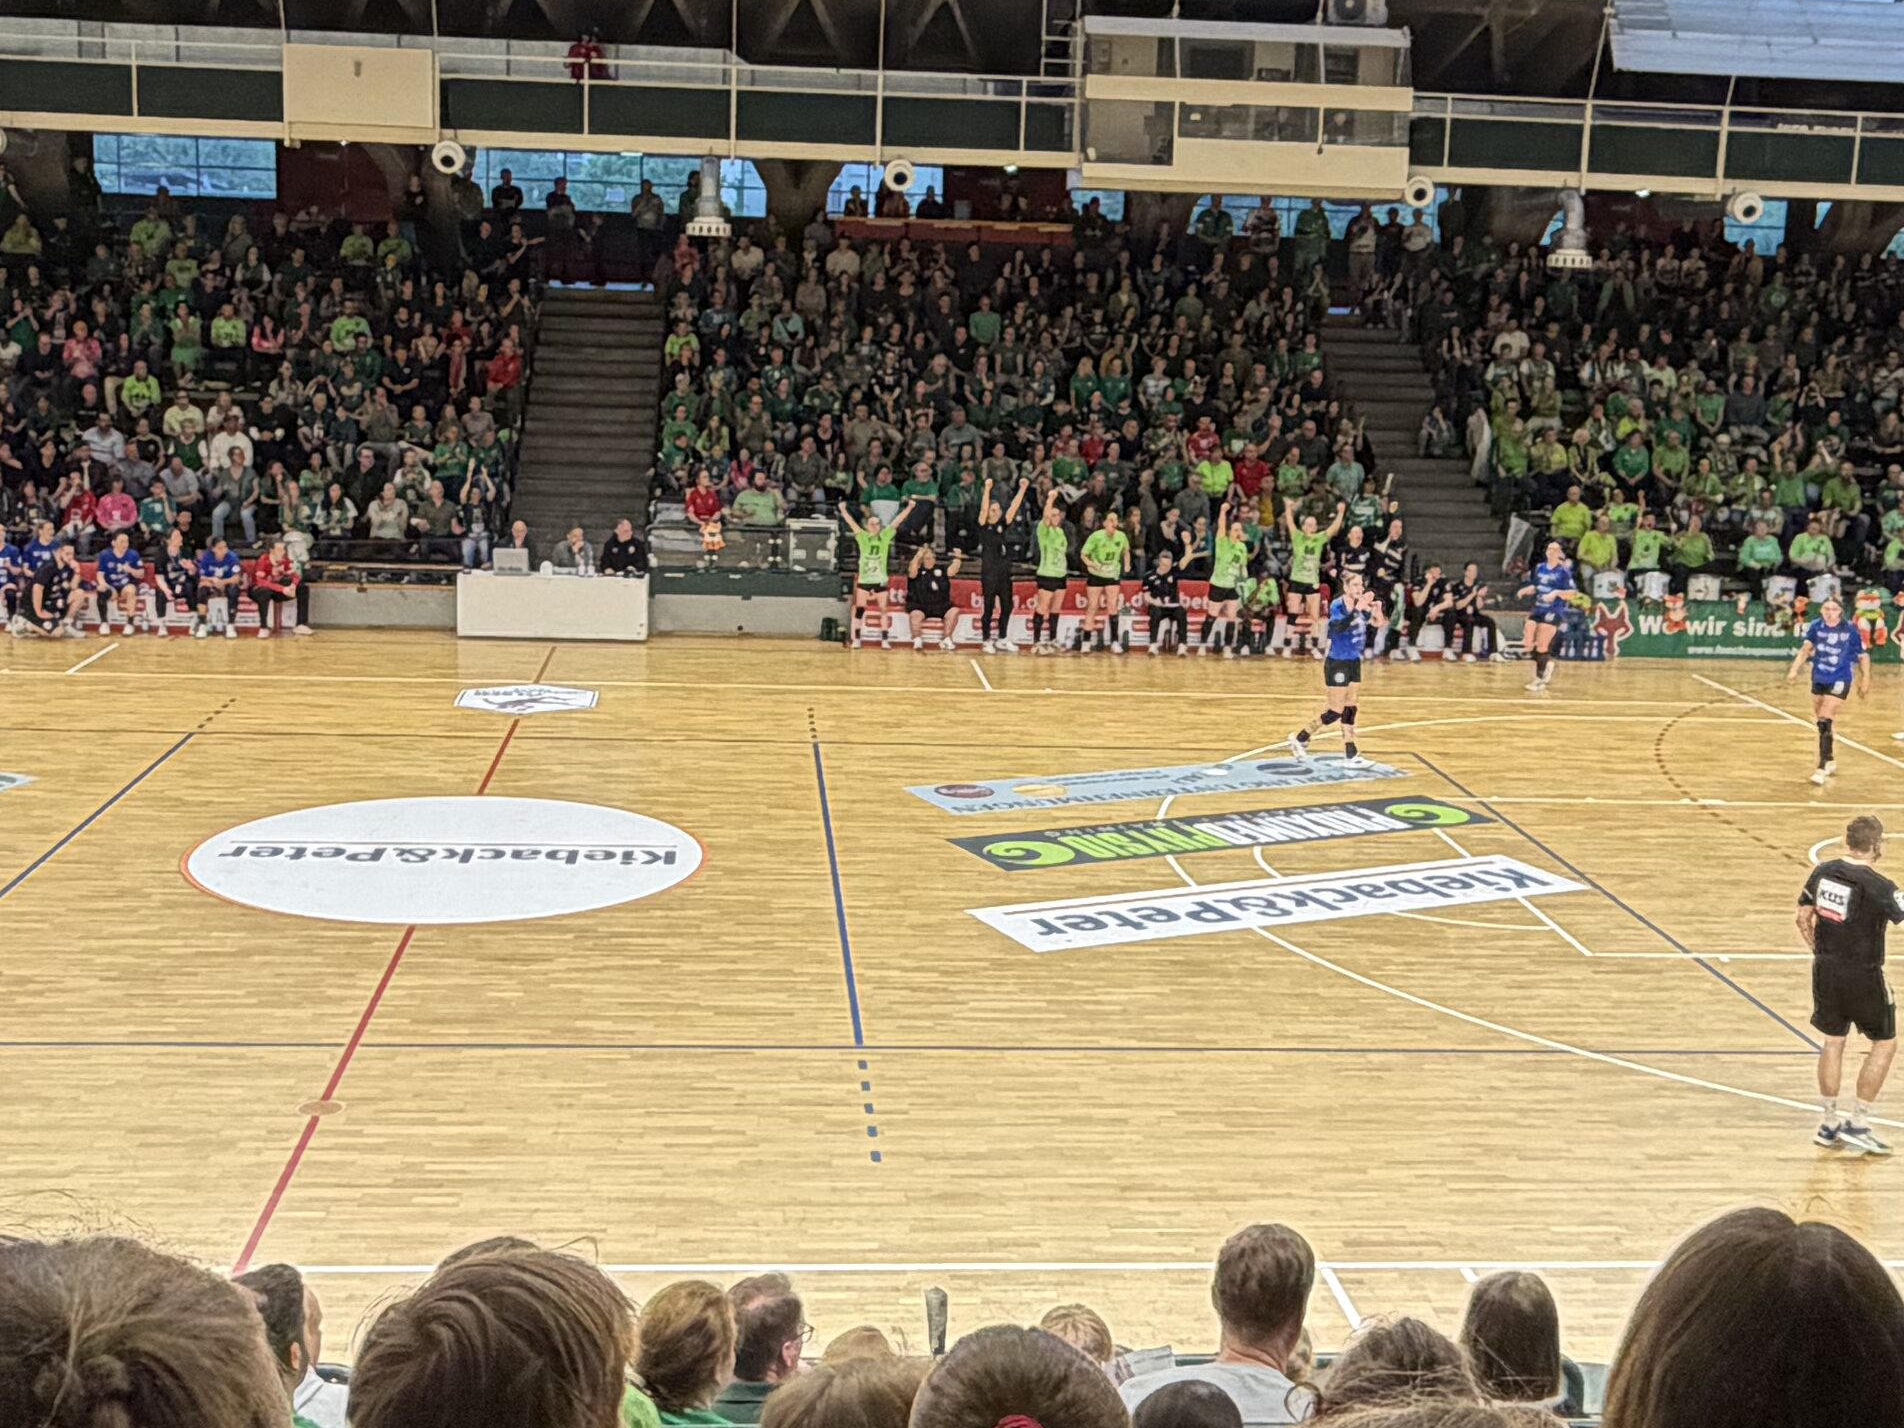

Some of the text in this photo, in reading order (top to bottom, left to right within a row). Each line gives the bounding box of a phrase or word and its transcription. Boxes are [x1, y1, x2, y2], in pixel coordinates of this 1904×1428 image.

[1686, 616, 1727, 636] wir
[217, 845, 678, 866] Kieback&Peter
[1026, 868, 1556, 938] Kieback&Peter
